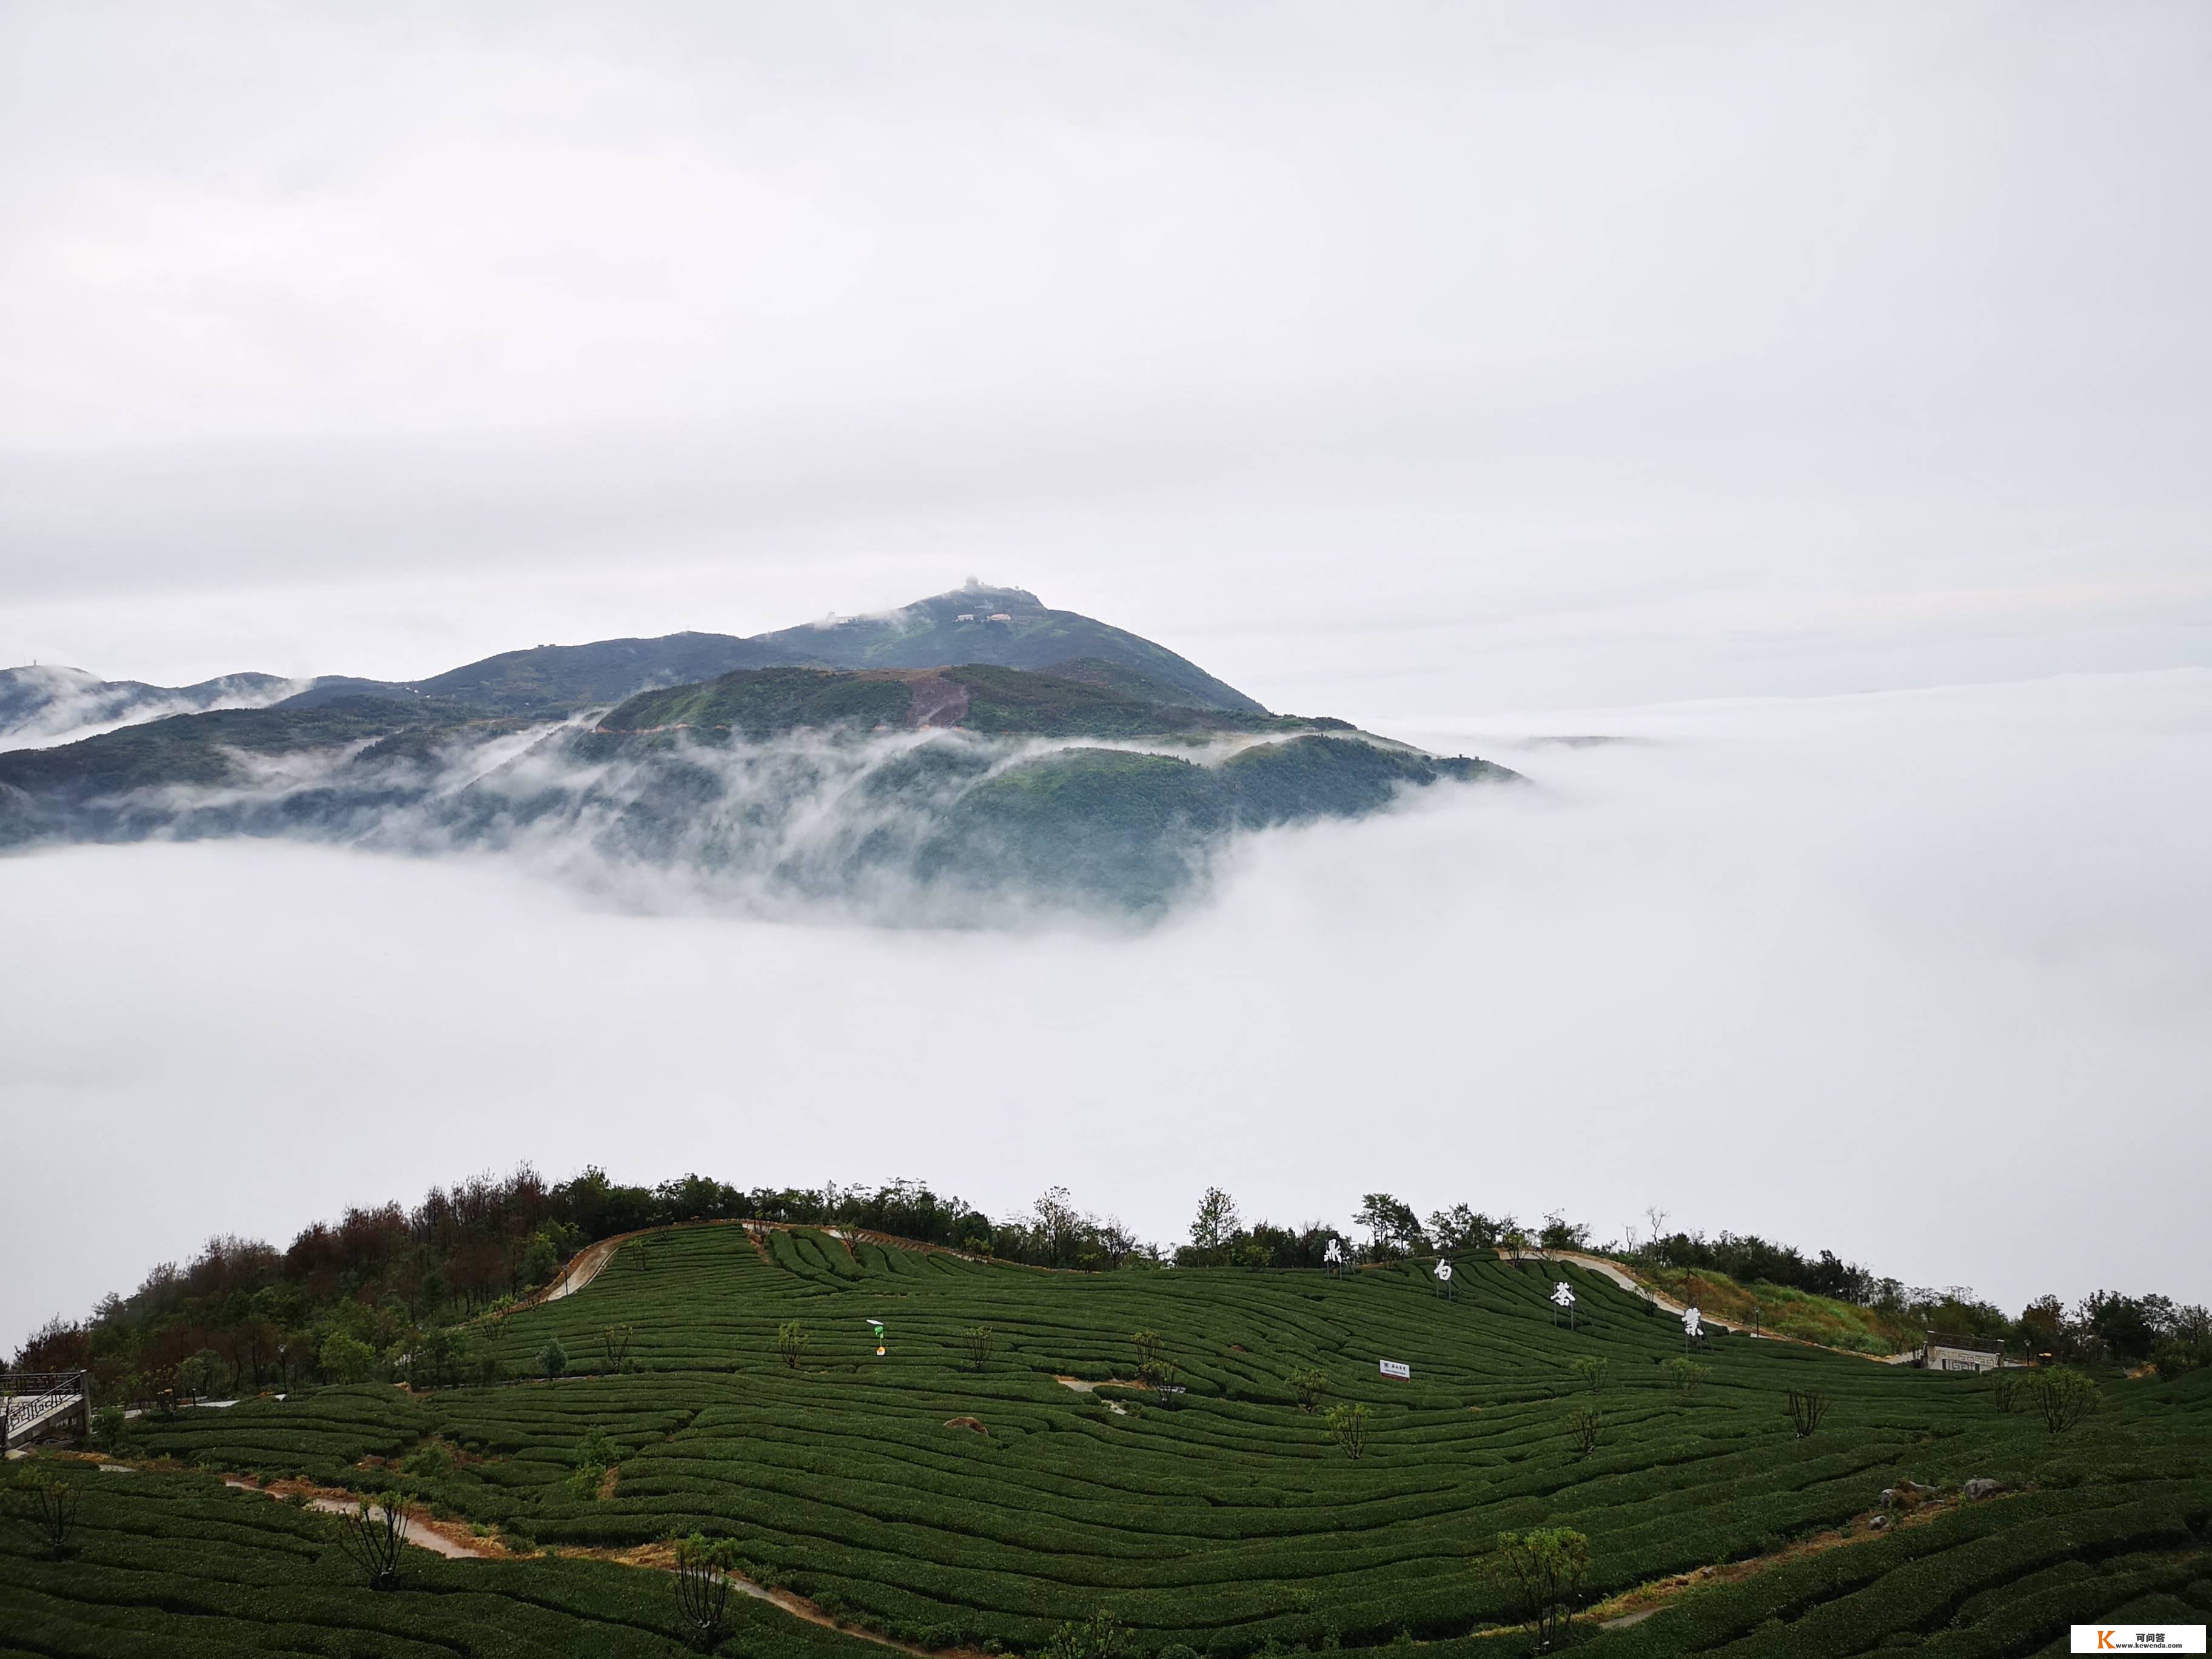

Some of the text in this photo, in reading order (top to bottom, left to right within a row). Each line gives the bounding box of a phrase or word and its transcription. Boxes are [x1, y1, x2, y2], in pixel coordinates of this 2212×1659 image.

[1324, 1239, 1342, 1264] 鼎
[1433, 1258, 1452, 1281] 白
[1550, 1282, 1576, 1306] 茶
